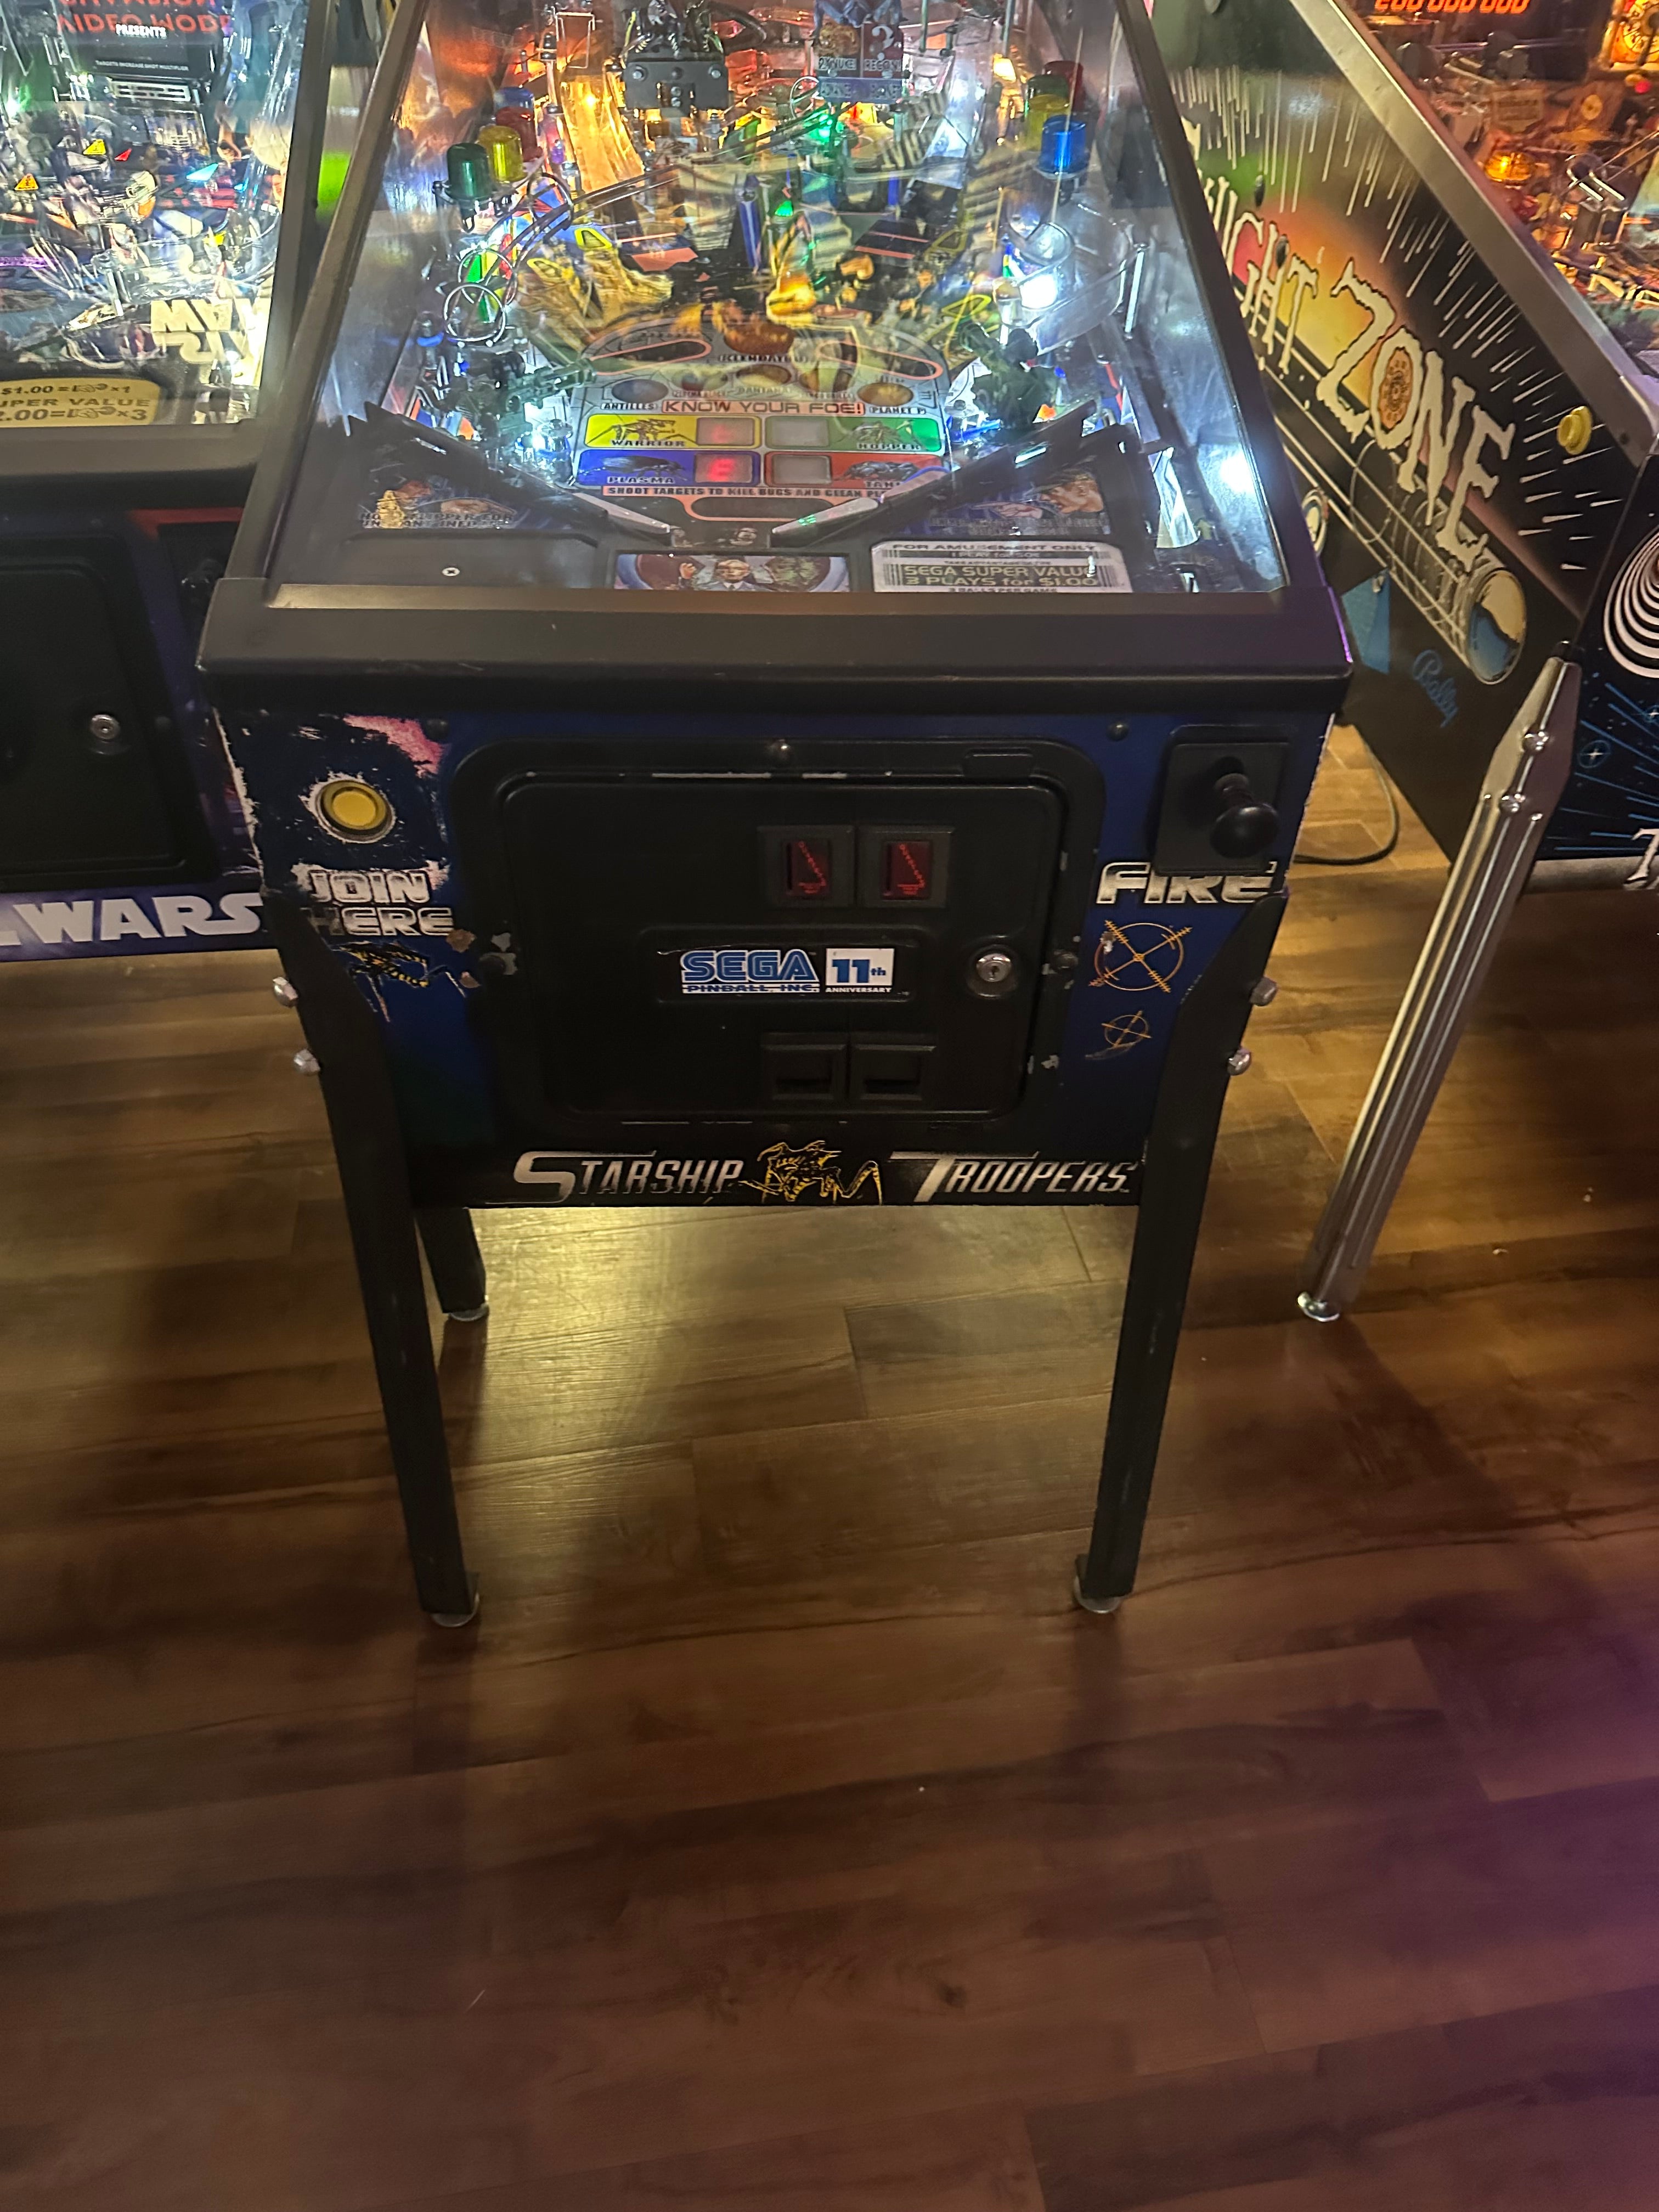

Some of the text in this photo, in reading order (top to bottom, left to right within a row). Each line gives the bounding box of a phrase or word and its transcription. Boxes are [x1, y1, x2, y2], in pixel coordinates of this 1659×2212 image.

[115, 24, 167, 38] PRESENTS
[0, 399, 59, 408] UPER
[665, 401, 861, 414] KNOW YOUR FOE!
[1317, 257, 1516, 572] ZONE
[857, 442, 922, 451] HOPPER
[905, 566, 957, 576] SEGA
[962, 567, 1029, 577] SUPER
[926, 577, 996, 586] PLAYS
[1002, 578, 1034, 586] for
[1039, 578, 1097, 586] $1.00
[310, 870, 431, 904] JOIN
[1096, 861, 1284, 905] FIRE
[12, 892, 264, 944] WARS
[300, 907, 454, 936] HERE
[680, 949, 887, 984] SEGA 11th
[779, 984, 818, 993] INC.
[514, 1150, 1139, 1203] STARSHIP TROOPERS
